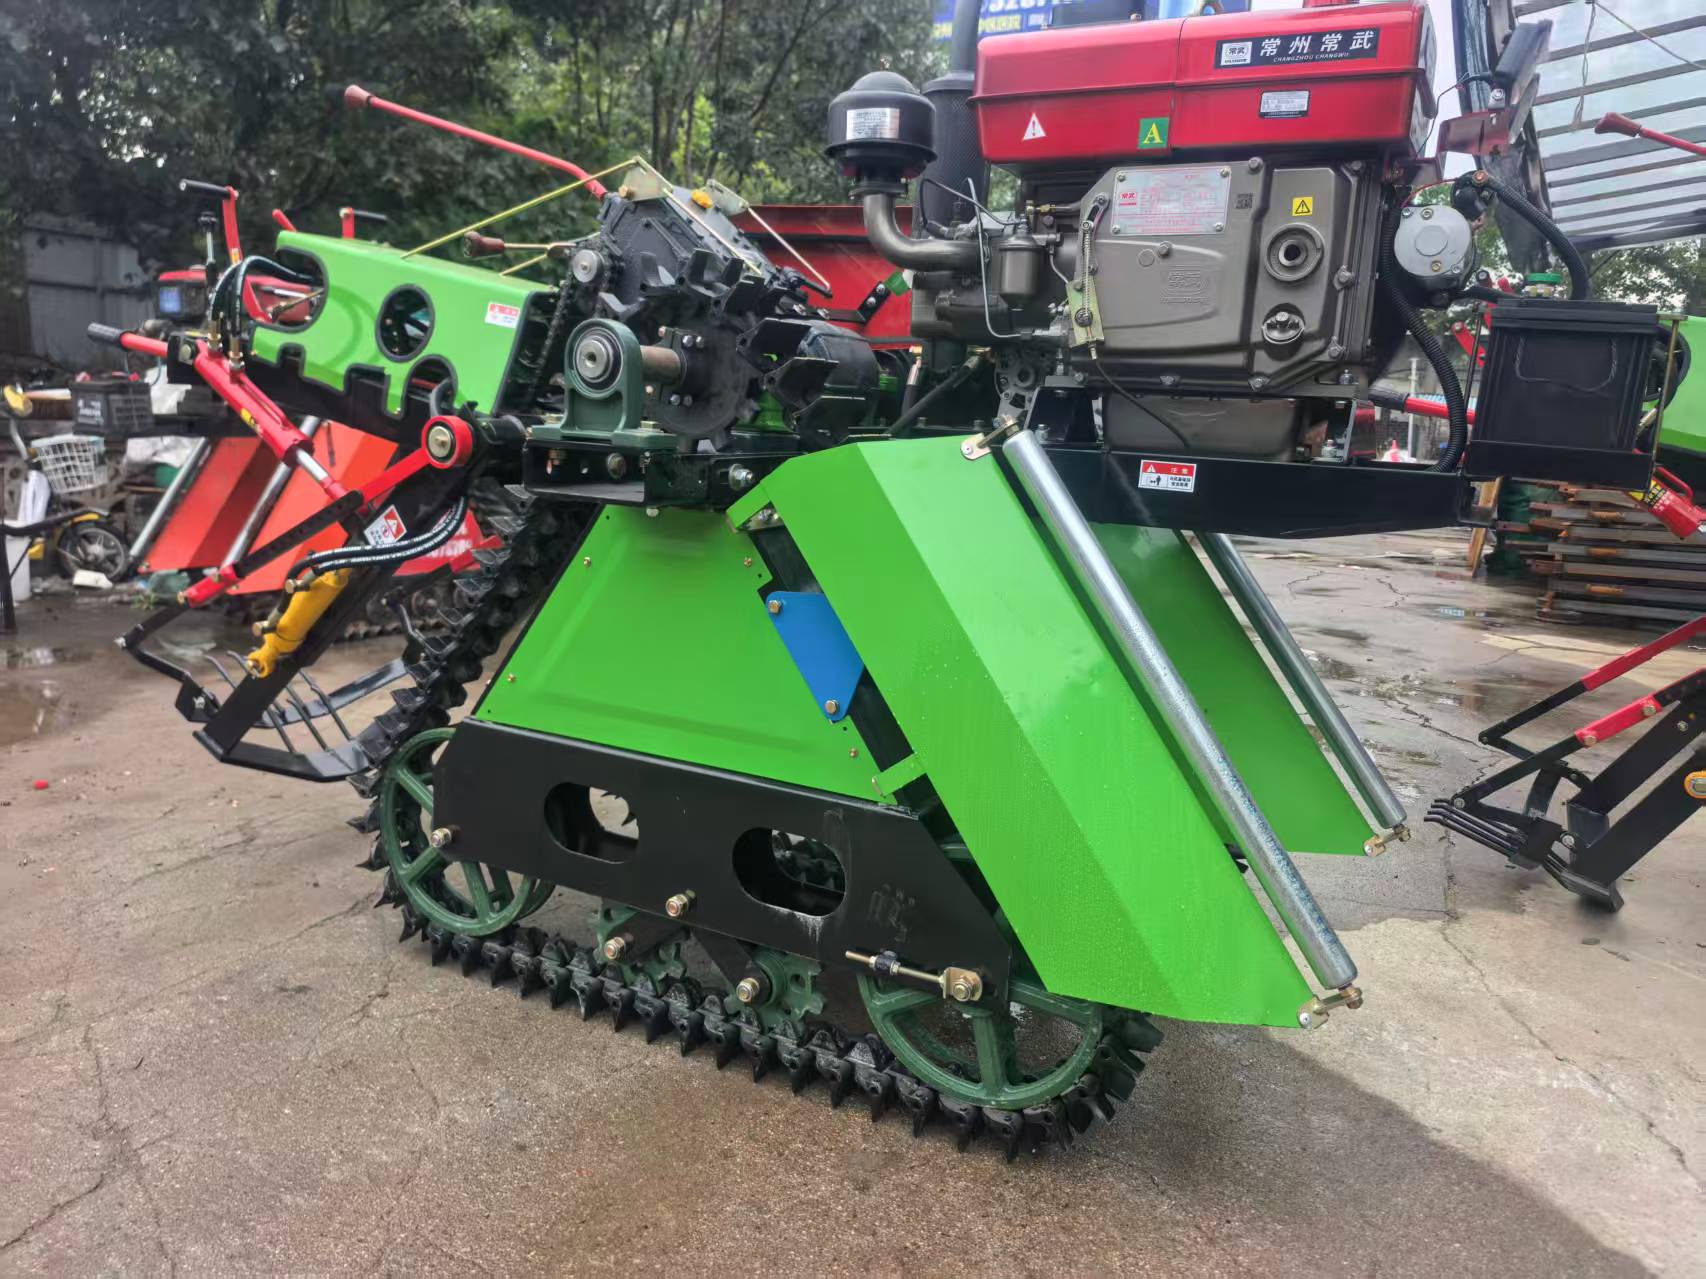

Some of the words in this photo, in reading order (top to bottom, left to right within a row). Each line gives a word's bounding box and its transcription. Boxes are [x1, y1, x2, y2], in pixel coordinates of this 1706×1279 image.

[1260, 30, 1374, 57] 常州常武
[1273, 54, 1314, 63] CHANGZHOU
[1143, 122, 1164, 144] A
